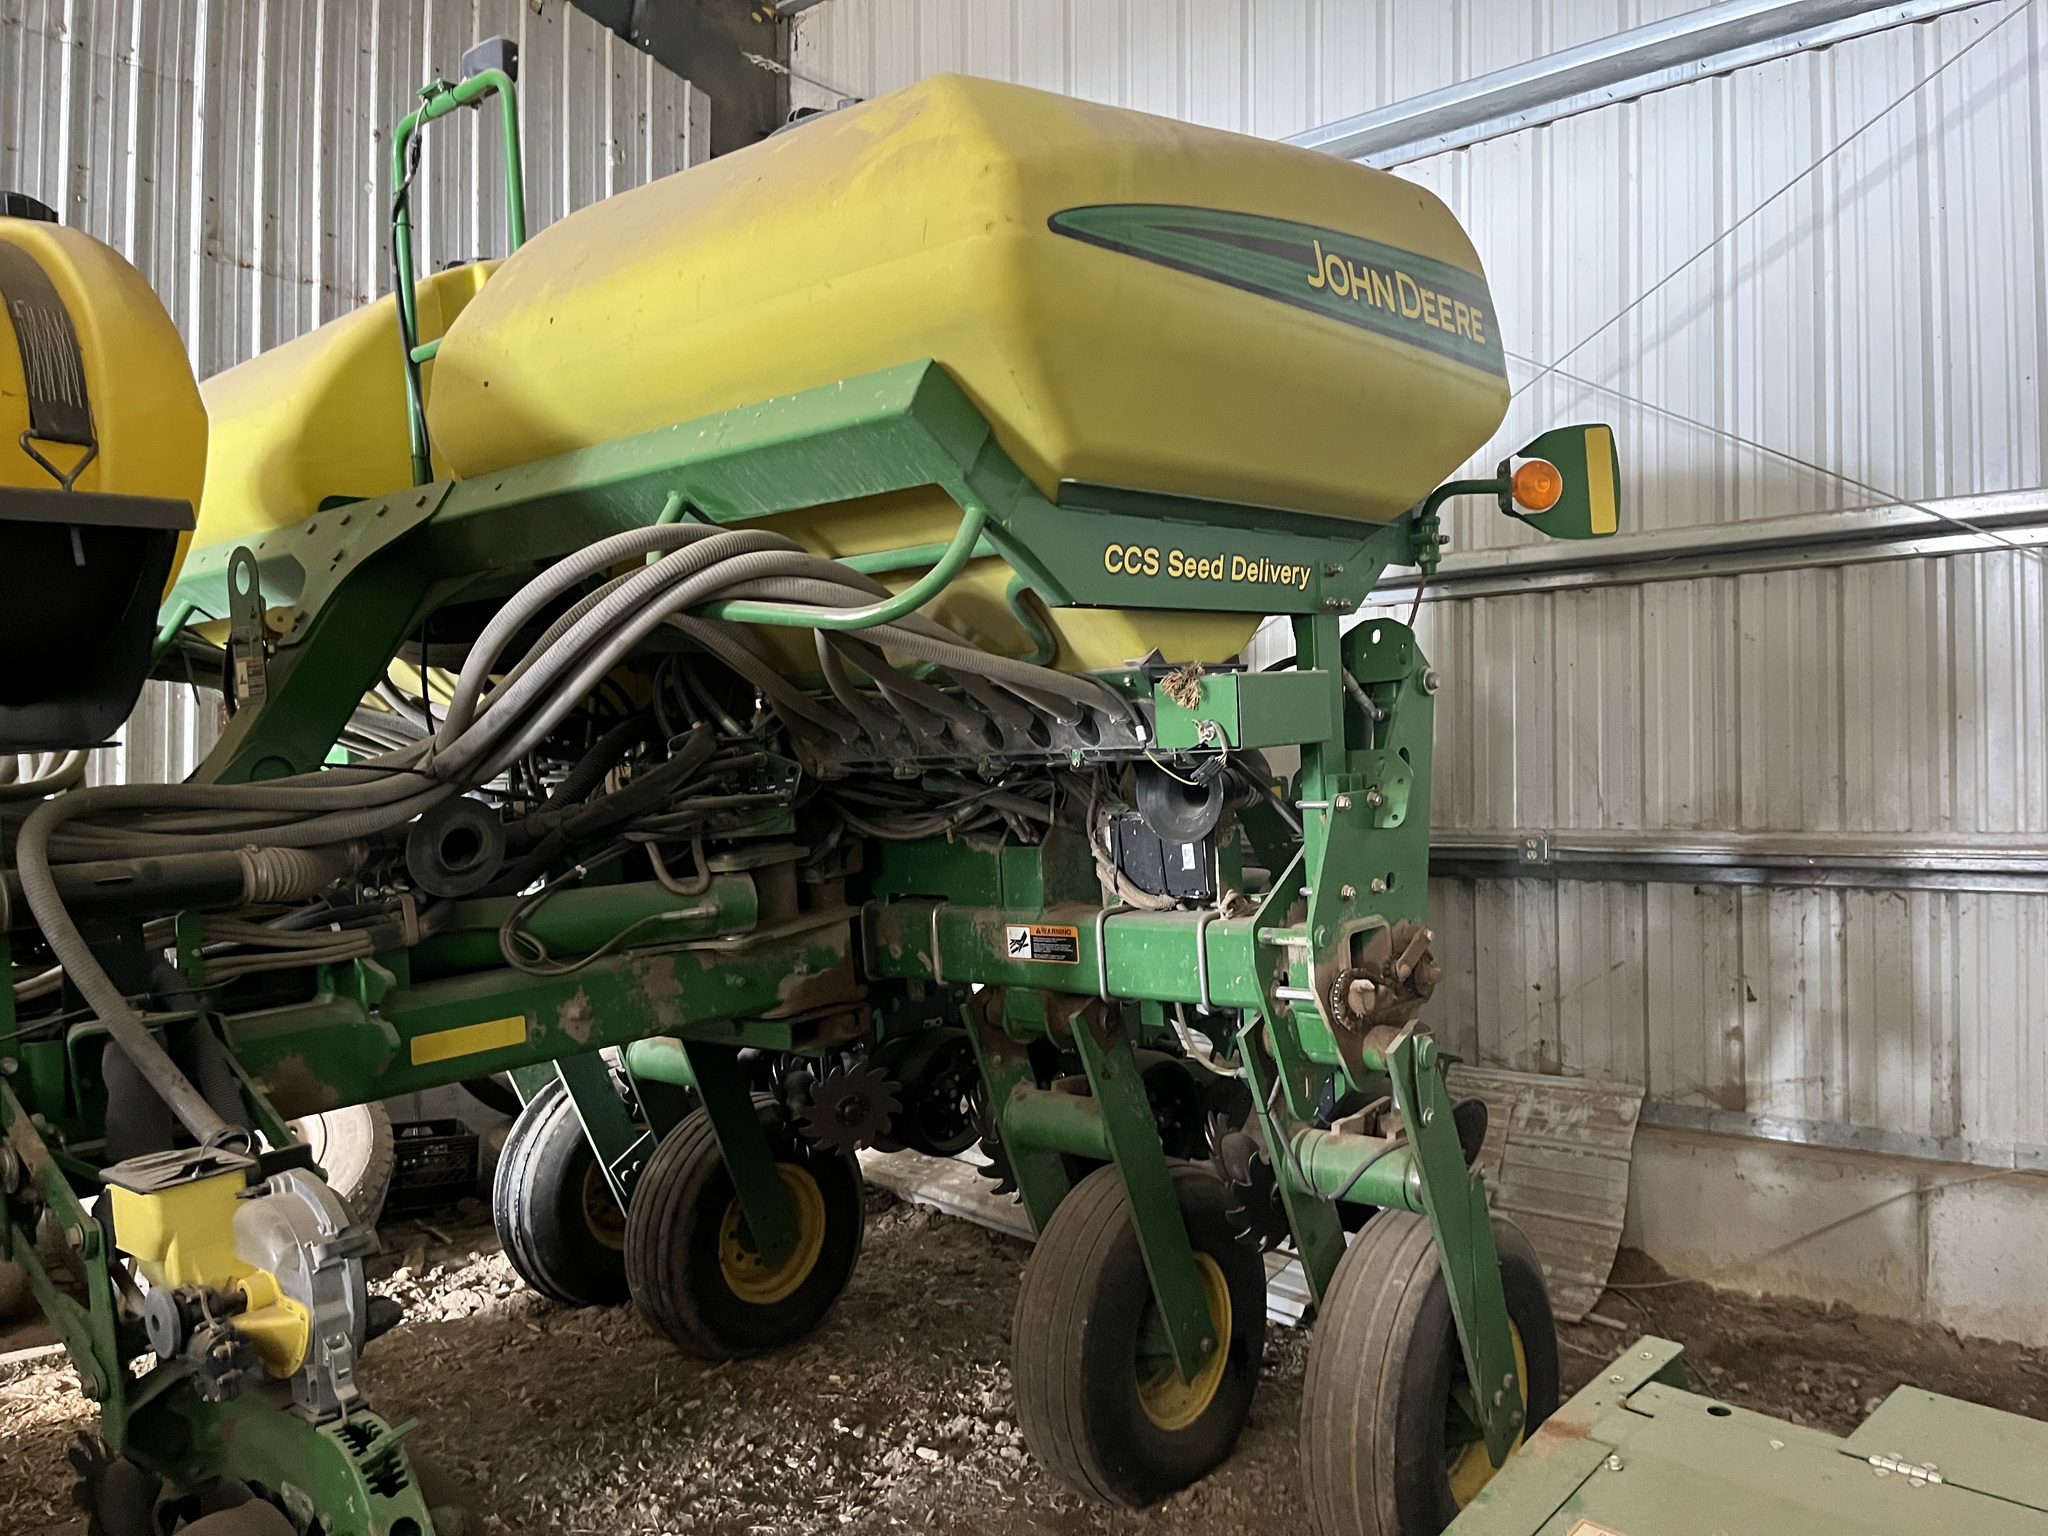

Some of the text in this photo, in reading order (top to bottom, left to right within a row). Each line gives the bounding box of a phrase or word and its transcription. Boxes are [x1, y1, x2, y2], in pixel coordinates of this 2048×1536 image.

[1307, 239, 1486, 344] JOHN DEERE
[1104, 543, 1311, 591] CCS Seed Delivery
[1041, 927, 1072, 936] WARNING
